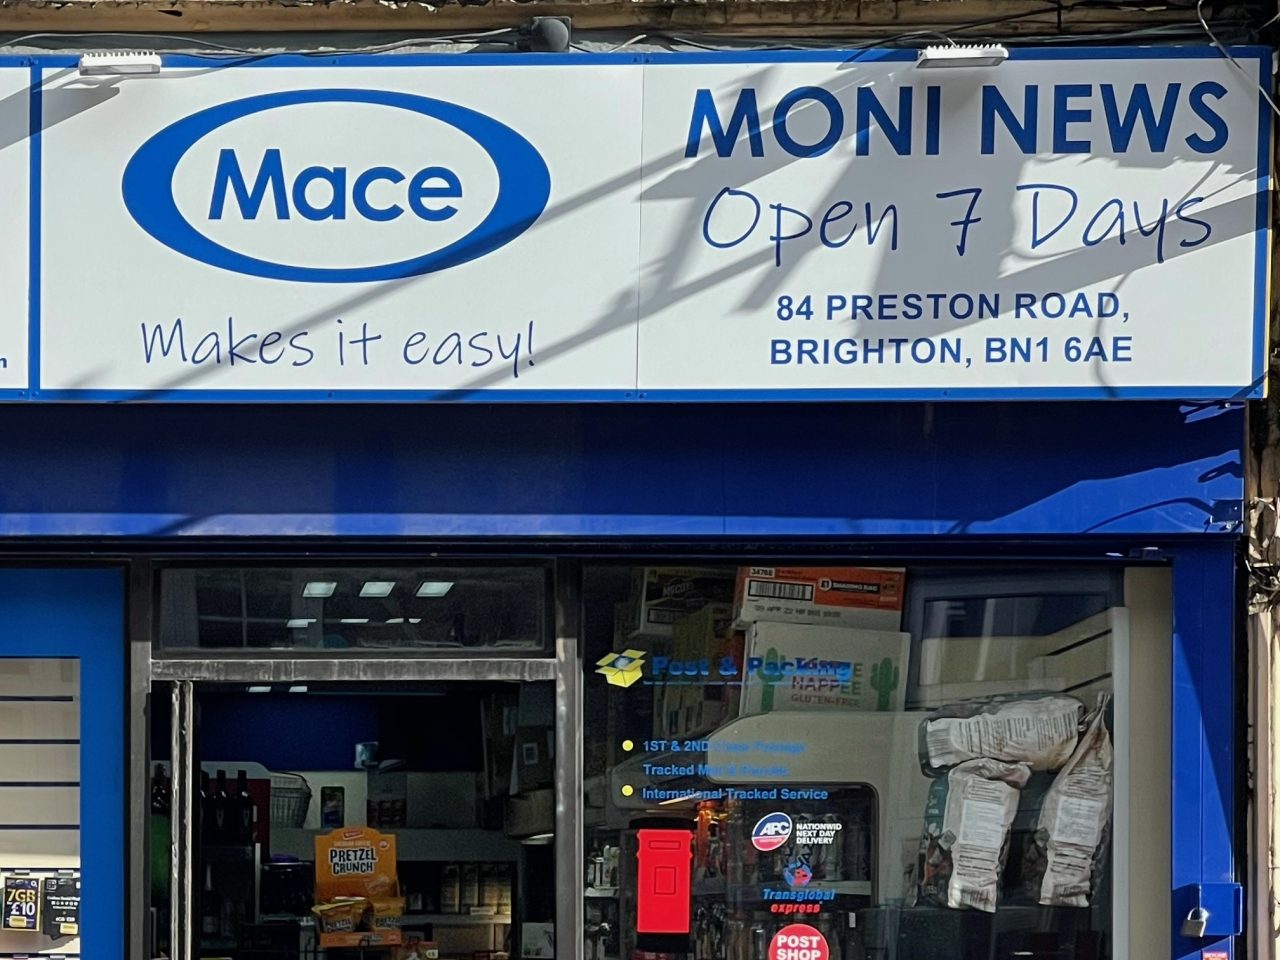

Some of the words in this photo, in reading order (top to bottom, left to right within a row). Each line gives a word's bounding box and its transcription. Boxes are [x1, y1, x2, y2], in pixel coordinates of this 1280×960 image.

[684, 85, 941, 159] MONI
[980, 81, 1229, 156] NEWS
[208, 148, 463, 222] Mace
[702, 186, 899, 268] Open
[936, 187, 983, 257] 7
[1016, 183, 1212, 264] Days
[776, 295, 813, 320] 84
[826, 294, 1000, 321] PRESTON
[1015, 292, 1129, 323] ROAD,
[141, 316, 314, 367] Makes
[338, 320, 382, 366] it
[403, 320, 535, 378] easy!
[770, 338, 972, 368] BRIGHTON,
[985, 337, 1049, 363] BN1
[1064, 336, 1133, 362] 6AE
[652, 656, 709, 676] Post
[719, 656, 738, 676] &
[643, 740, 667, 752] 1ST
[670, 740, 681, 752] &
[684, 740, 708, 752] 2ND
[643, 764, 694, 776] Tracked
[643, 788, 722, 800] International
[726, 788, 777, 800] Tracked
[780, 788, 828, 800] Service
[760, 822, 790, 835] APC
[330, 848, 377, 863] PRETZEL
[333, 862, 373, 874] CRUNCH
[8, 889, 36, 902] 7GB
[763, 889, 836, 902] Transglobal
[10, 902, 36, 916] £10
[771, 903, 820, 915] express
[777, 935, 821, 948] POST
